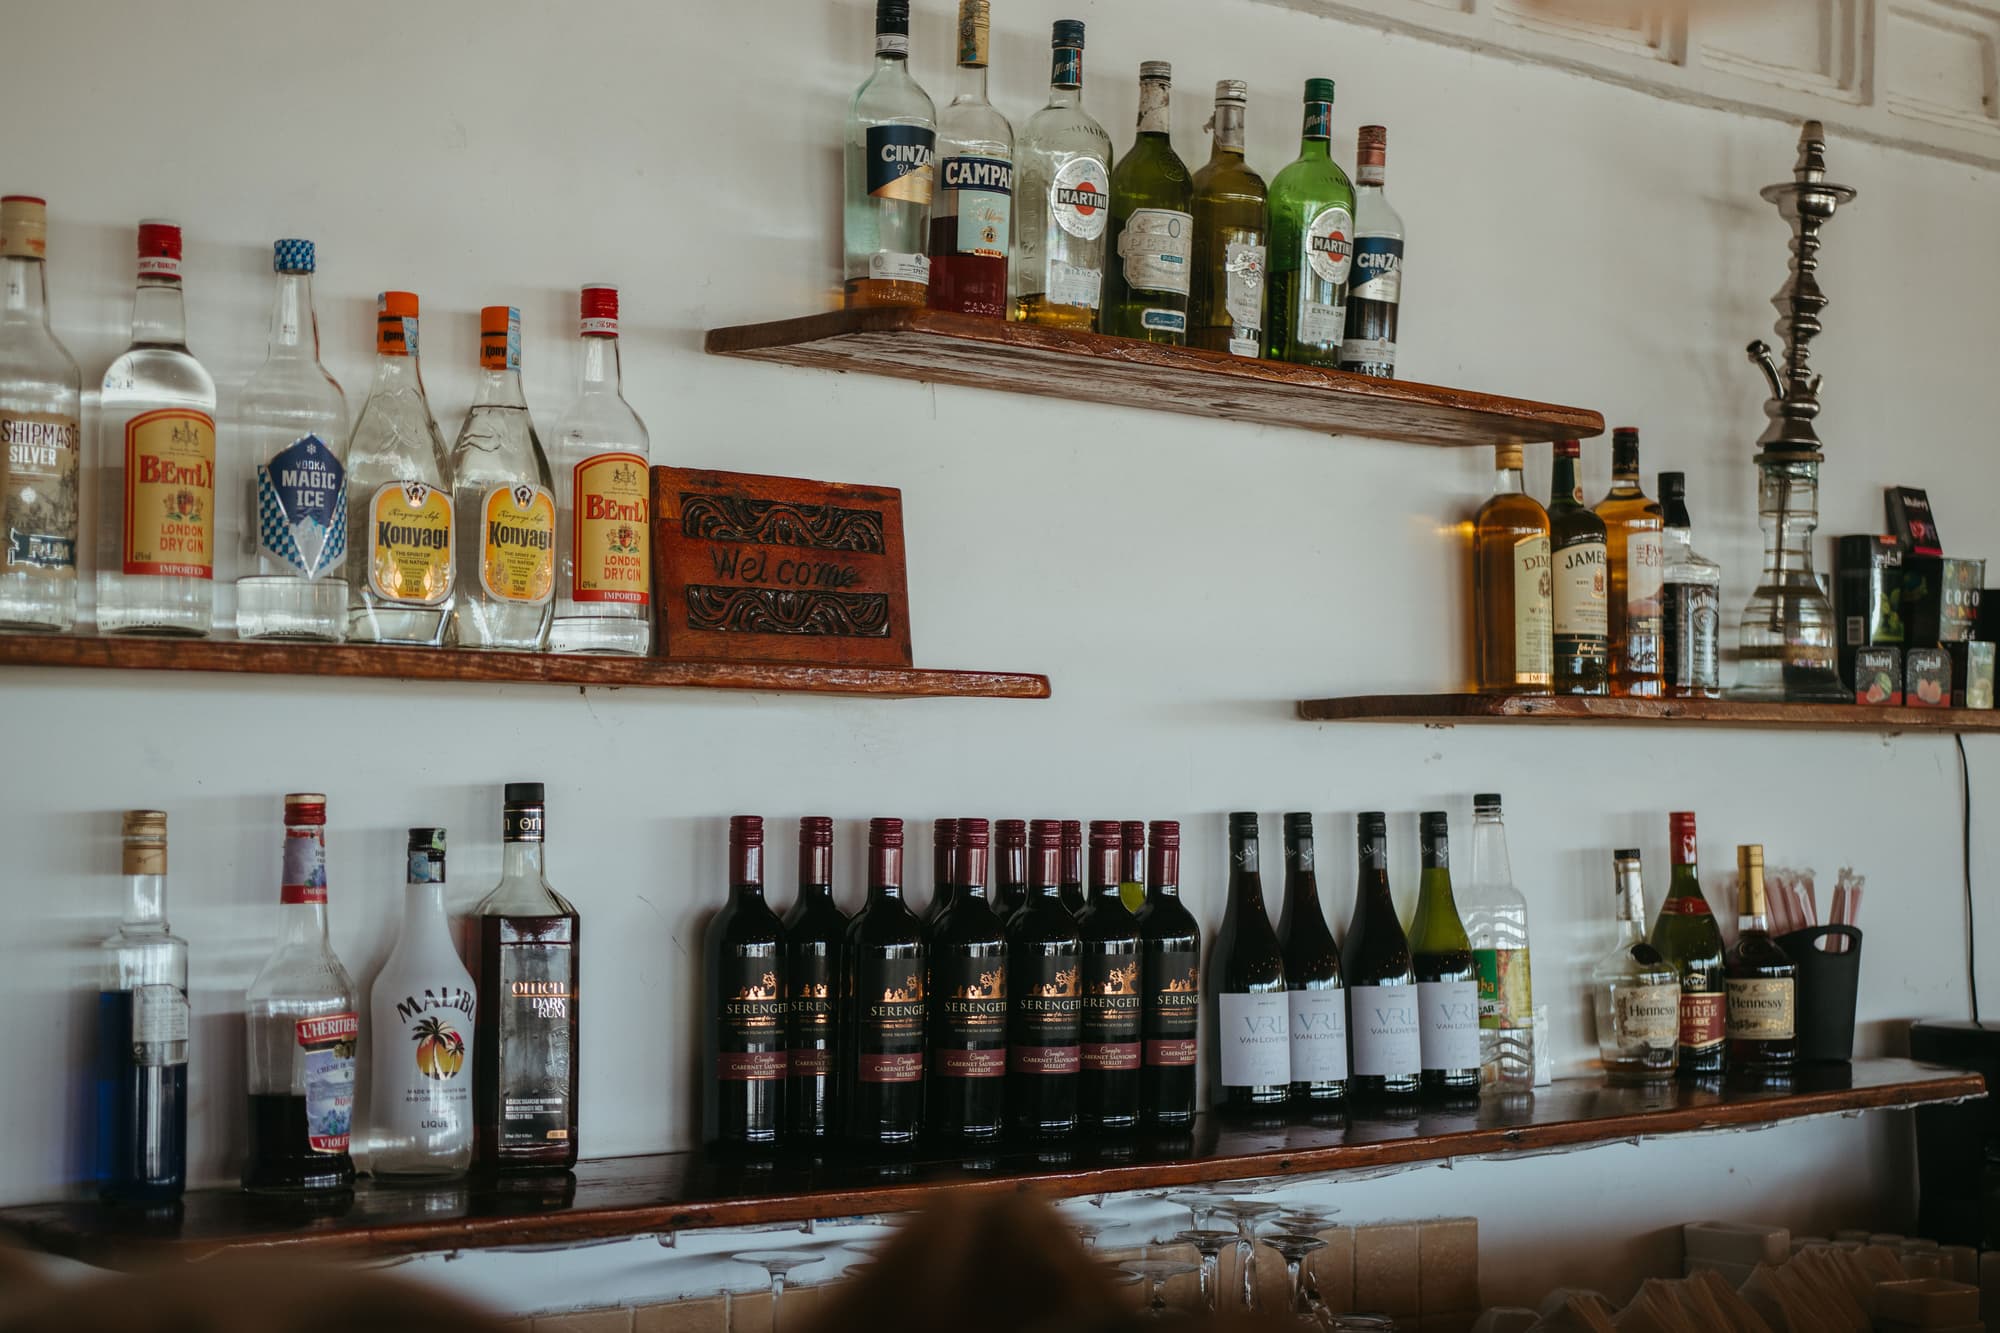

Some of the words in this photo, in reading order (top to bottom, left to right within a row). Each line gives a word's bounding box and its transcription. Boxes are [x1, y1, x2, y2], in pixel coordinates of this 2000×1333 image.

[1059, 189, 1106, 210] MARTINI
[9, 445, 57, 466] SILVER
[296, 460, 326, 471] VODKA
[282, 469, 336, 490] MAGIC
[296, 490, 325, 508] ICE
[160, 523, 204, 538] LONDON
[378, 520, 448, 549] Konyagi
[489, 521, 553, 551] Konyagi
[160, 536, 184, 551] DRY
[186, 539, 204, 554] GIN
[605, 554, 641, 568] LONDON
[160, 564, 204, 577] IMPORTED
[603, 567, 625, 581] DRY
[626, 569, 641, 582] GIN
[603, 591, 642, 601] IMPORTED
[1945, 589, 1980, 607] COCO
[512, 980, 565, 995] omen
[1682, 977, 1706, 987] KWV
[532, 997, 565, 1009] DARK
[1731, 996, 1783, 1010] Hennessy
[538, 1006, 566, 1018] RUM
[1375, 1007, 1416, 1026] VRL
[1440, 1003, 1475, 1021] VRL
[1244, 1015, 1287, 1034] VRL
[1298, 1012, 1343, 1031] VRL
[1294, 1032, 1312, 1040] VAN
[1371, 1027, 1389, 1035] VAN
[1240, 1036, 1258, 1044] VAN
[1023, 1056, 1053, 1064] CABERNET
[1160, 1049, 1187, 1057] CABERNET
[731, 1063, 762, 1071] CABERNET
[874, 1065, 905, 1073] CABERNET
[947, 1060, 978, 1068] CABERNET
[421, 1120, 459, 1129] LIQUE
